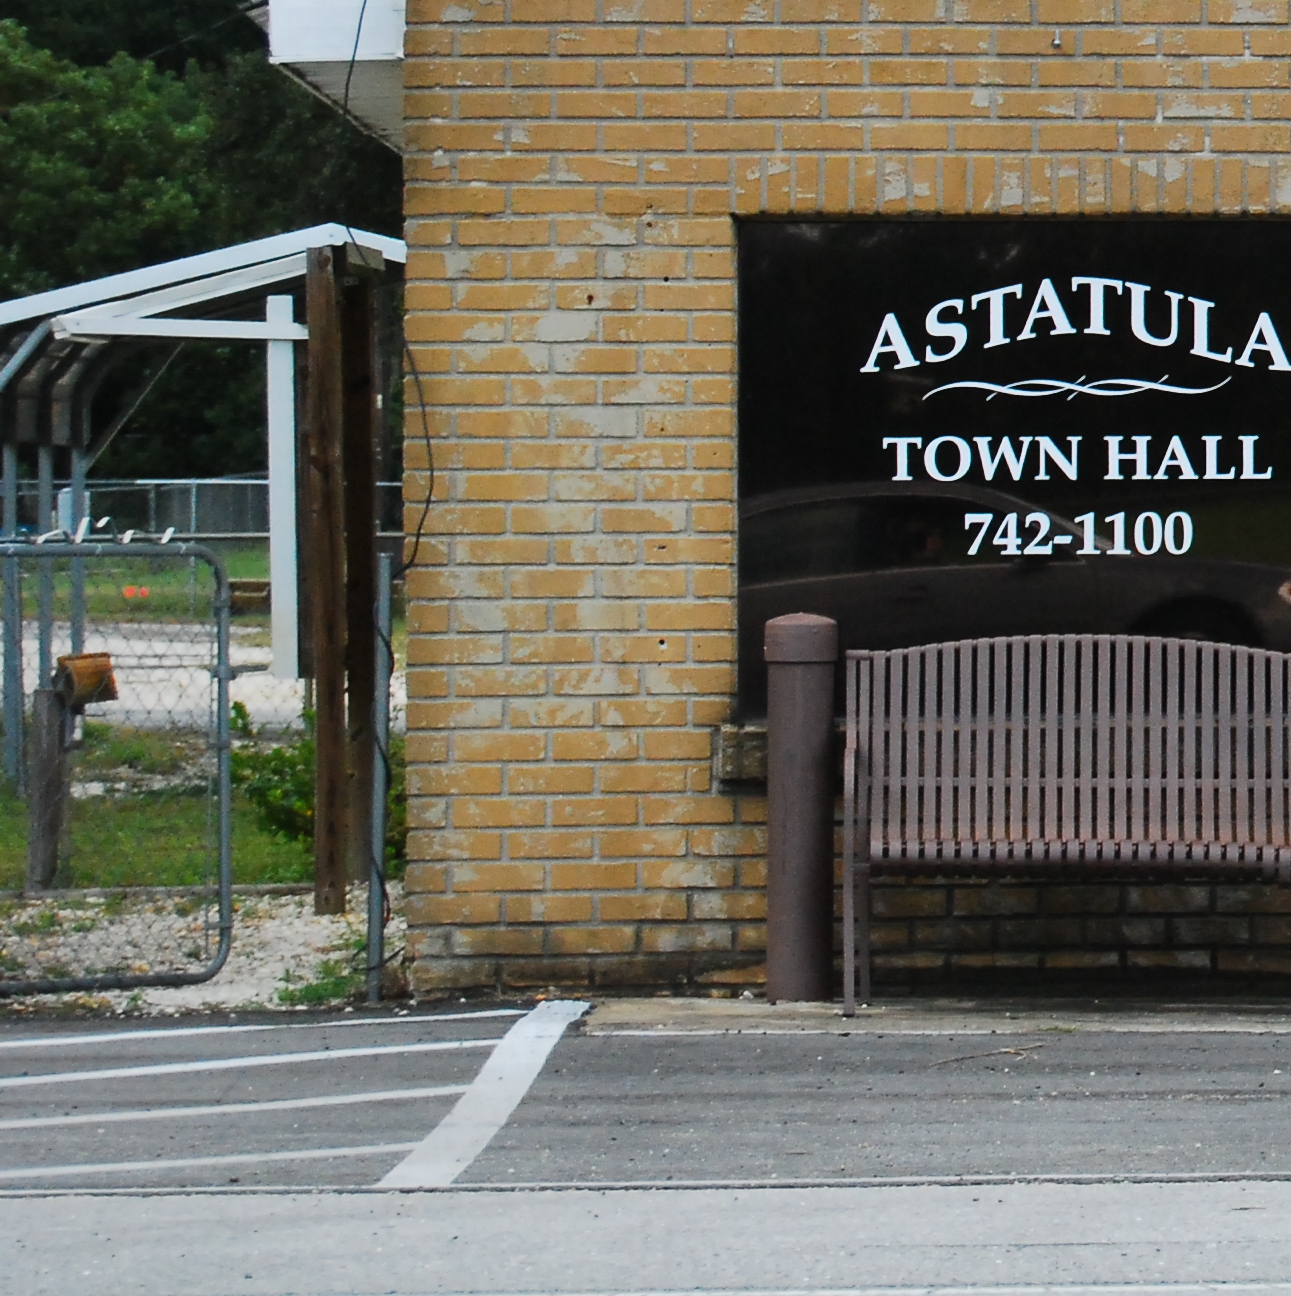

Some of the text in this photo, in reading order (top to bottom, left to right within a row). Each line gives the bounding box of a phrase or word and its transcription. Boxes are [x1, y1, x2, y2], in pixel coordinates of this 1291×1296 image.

[883, 435, 1273, 481] TOWN HALL
[964, 512, 1194, 556] 742-1100
